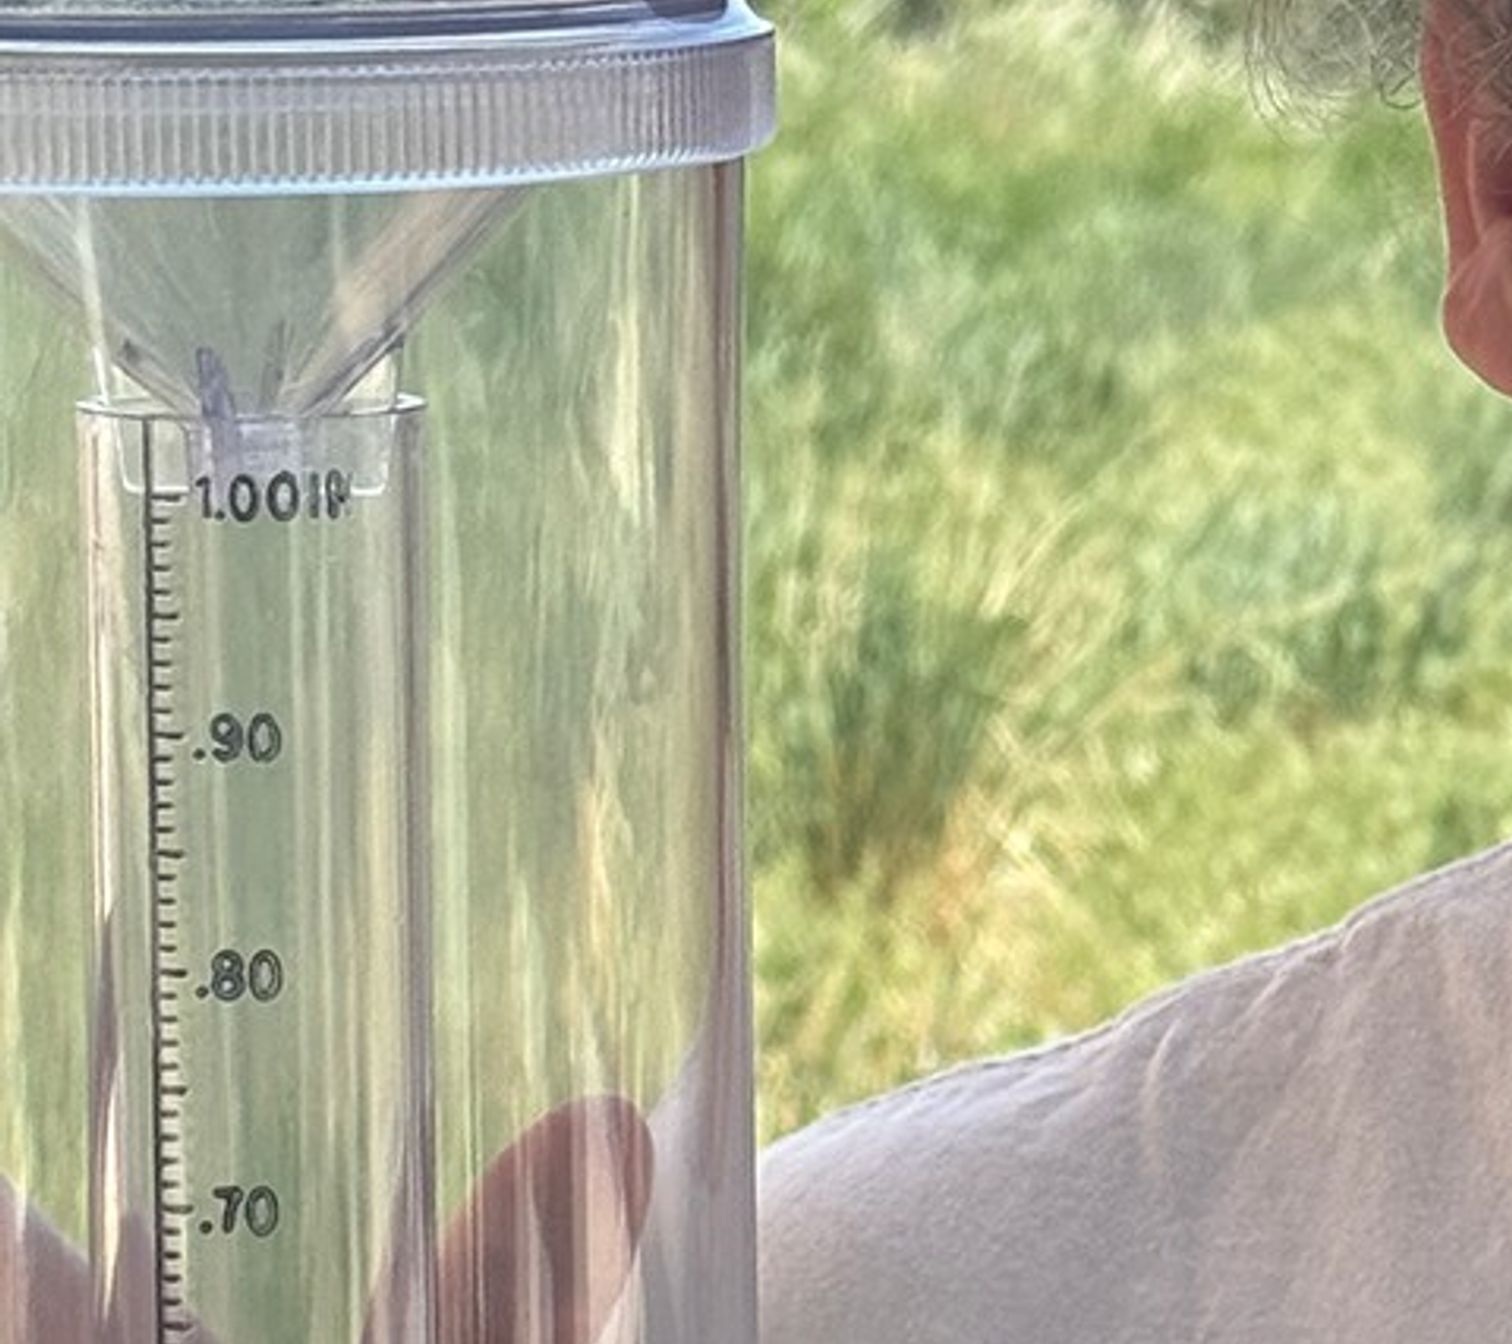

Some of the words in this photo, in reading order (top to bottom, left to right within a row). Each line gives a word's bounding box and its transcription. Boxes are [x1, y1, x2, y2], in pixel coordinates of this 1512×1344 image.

[194, 712, 282, 762] .90
[196, 949, 283, 1001] .80
[199, 1185, 279, 1237] .70
